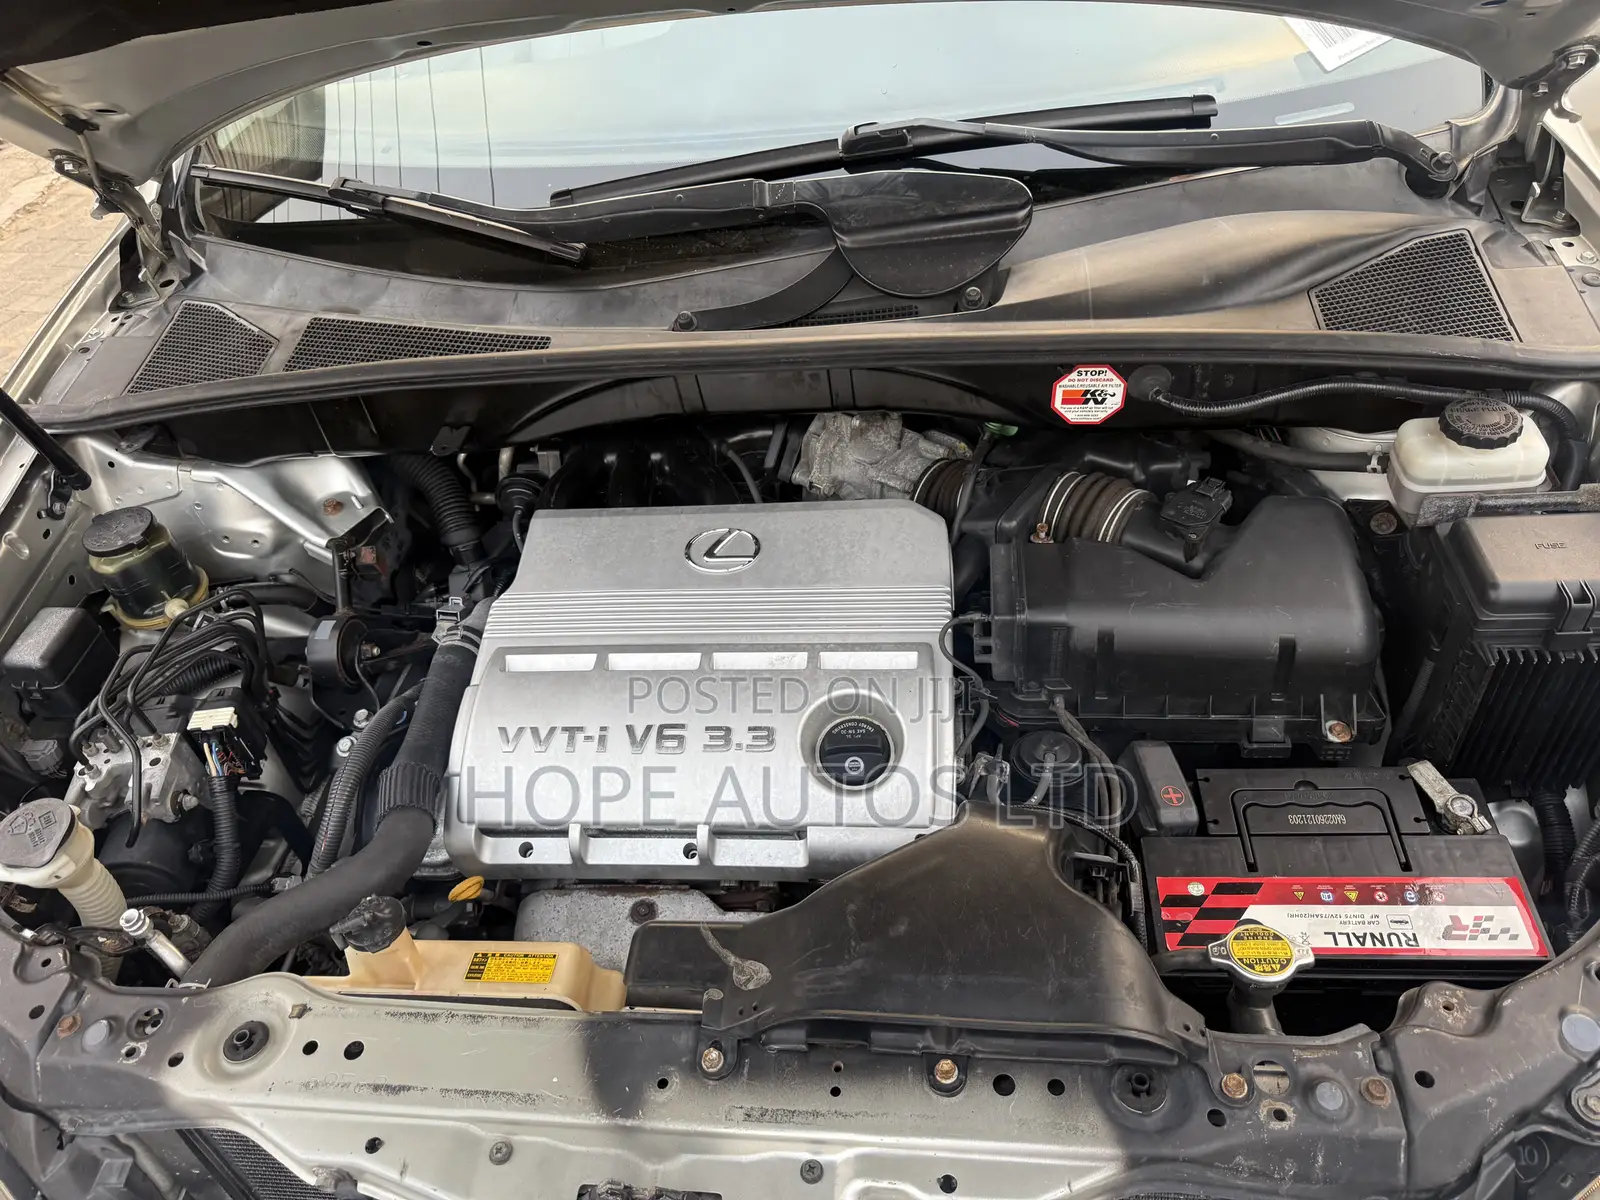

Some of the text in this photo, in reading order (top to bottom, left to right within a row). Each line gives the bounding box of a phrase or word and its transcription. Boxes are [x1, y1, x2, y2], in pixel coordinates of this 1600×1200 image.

[832, 722, 875, 734] ENERGY CONSERVING
[498, 724, 776, 754] VVT-i V6 3.3
[1288, 814, 1347, 824] 6A02260121203
[1324, 931, 1420, 948] RUNALL
[1518, 1146, 1538, 1166] 10
